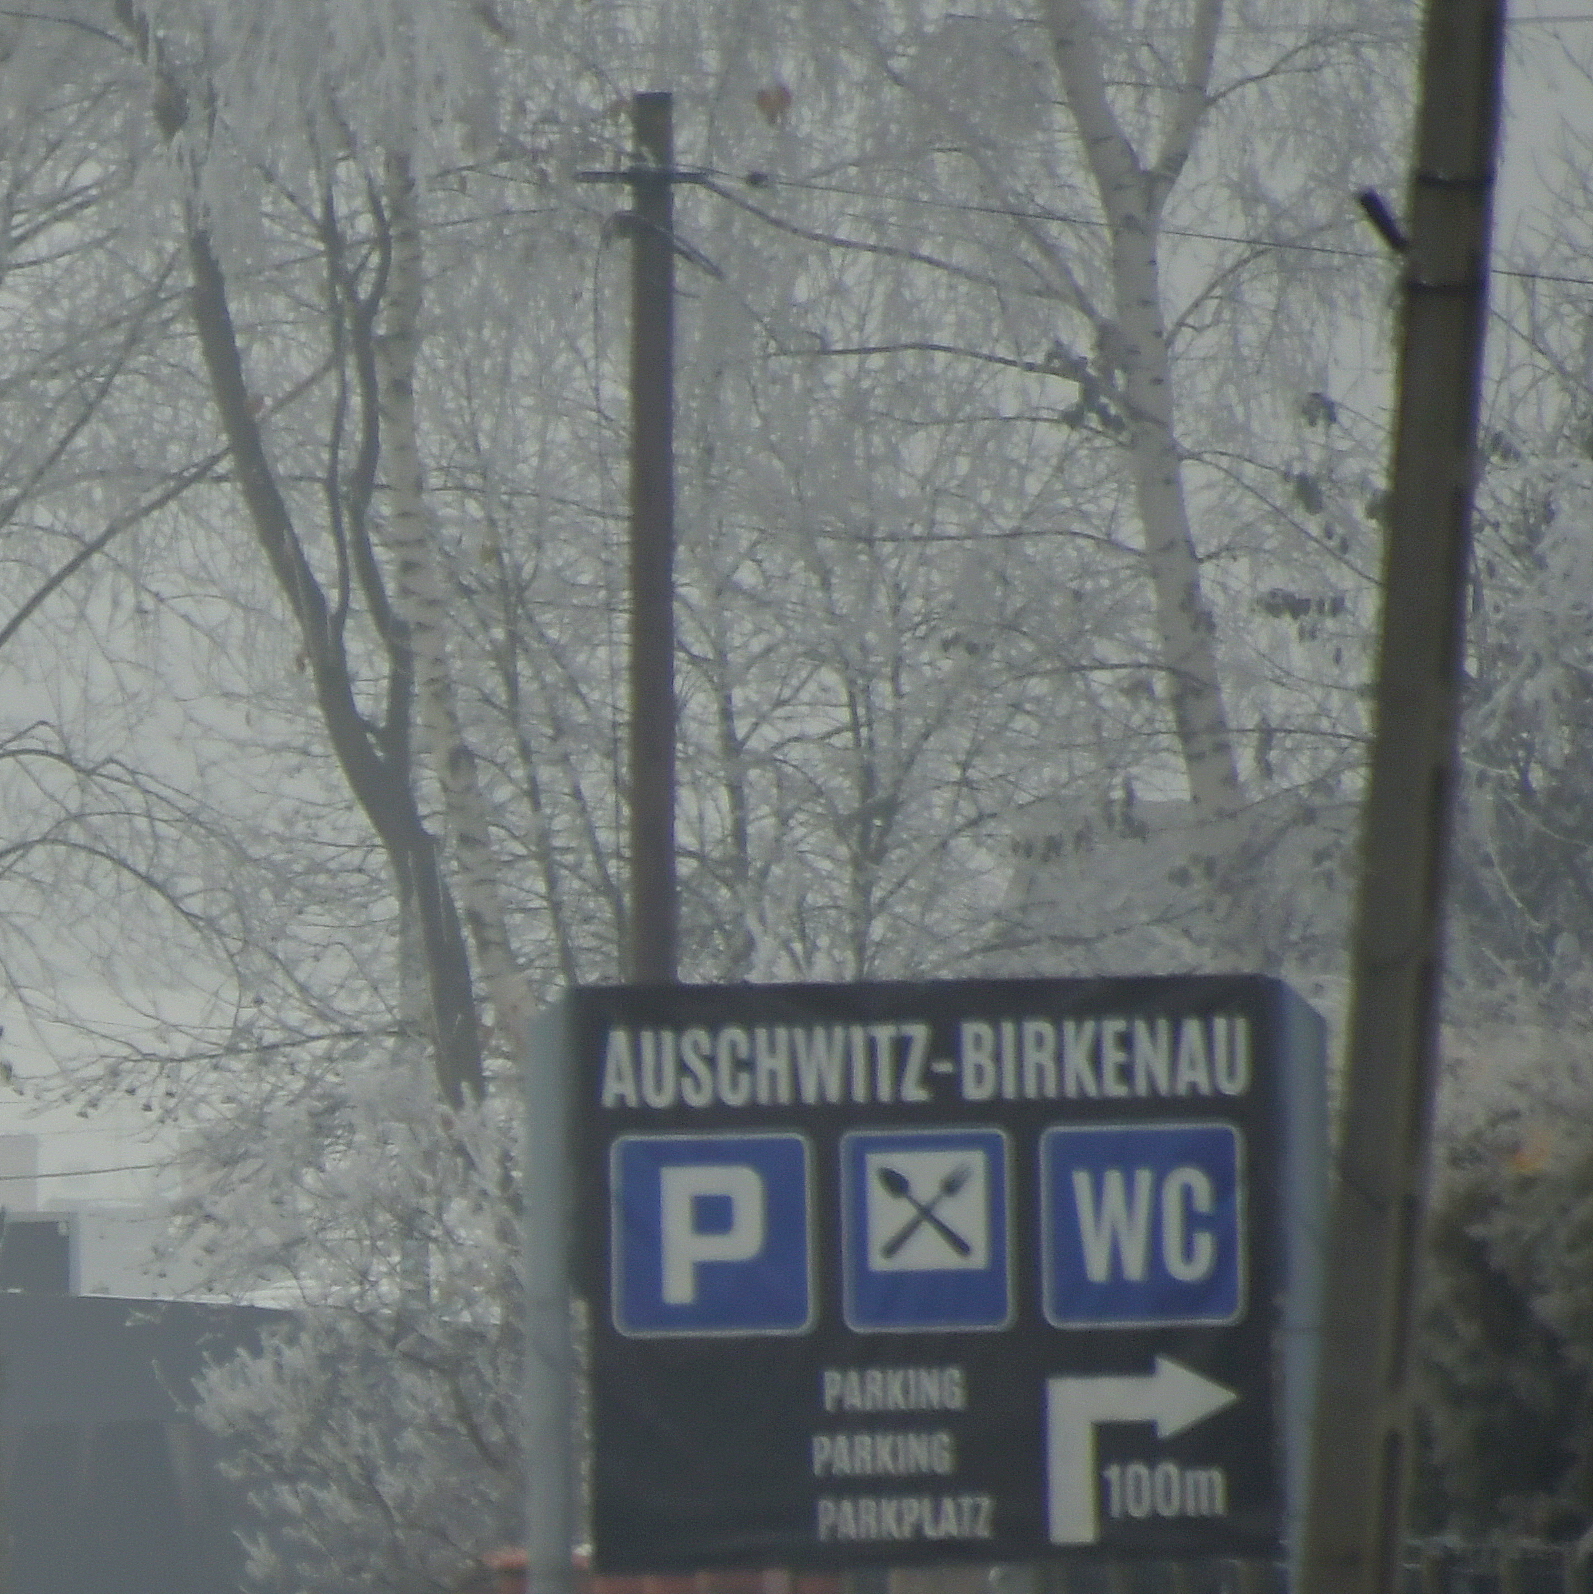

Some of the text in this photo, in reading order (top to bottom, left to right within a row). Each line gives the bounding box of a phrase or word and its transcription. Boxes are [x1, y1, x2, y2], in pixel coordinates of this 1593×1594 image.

[601, 1016, 1252, 1109] AUSCHWITZ-BIRKENAU
[659, 1164, 767, 1306] P
[1071, 1165, 1216, 1284] WC
[822, 1366, 967, 1413] PARKING
[813, 1431, 954, 1476] PARKING
[816, 1494, 994, 1542] PARKPLATZ
[1102, 1463, 1227, 1519] 100m
